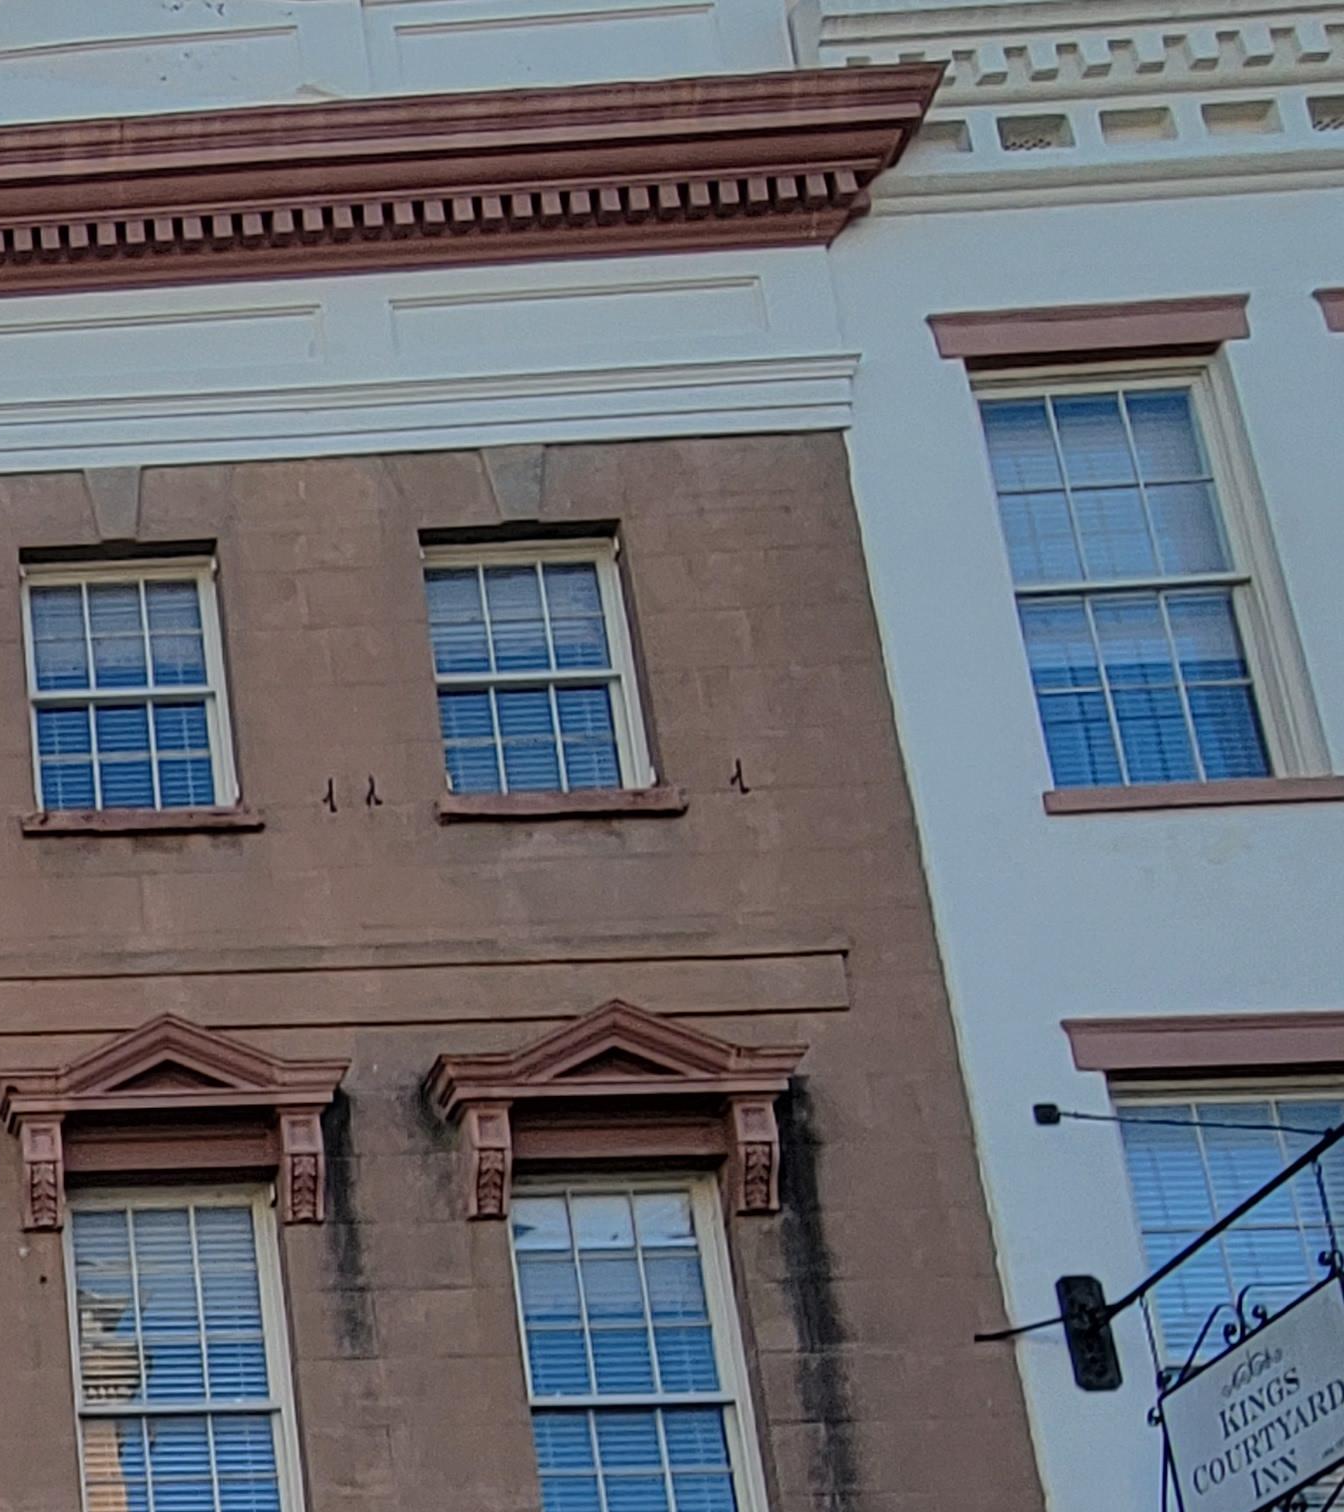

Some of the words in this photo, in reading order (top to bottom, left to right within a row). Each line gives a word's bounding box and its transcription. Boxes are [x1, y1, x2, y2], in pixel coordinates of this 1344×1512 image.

[1192, 1379, 1344, 1496] COURTYARD
[1218, 1366, 1301, 1440] KINGS
[1250, 1448, 1298, 1499] INN
